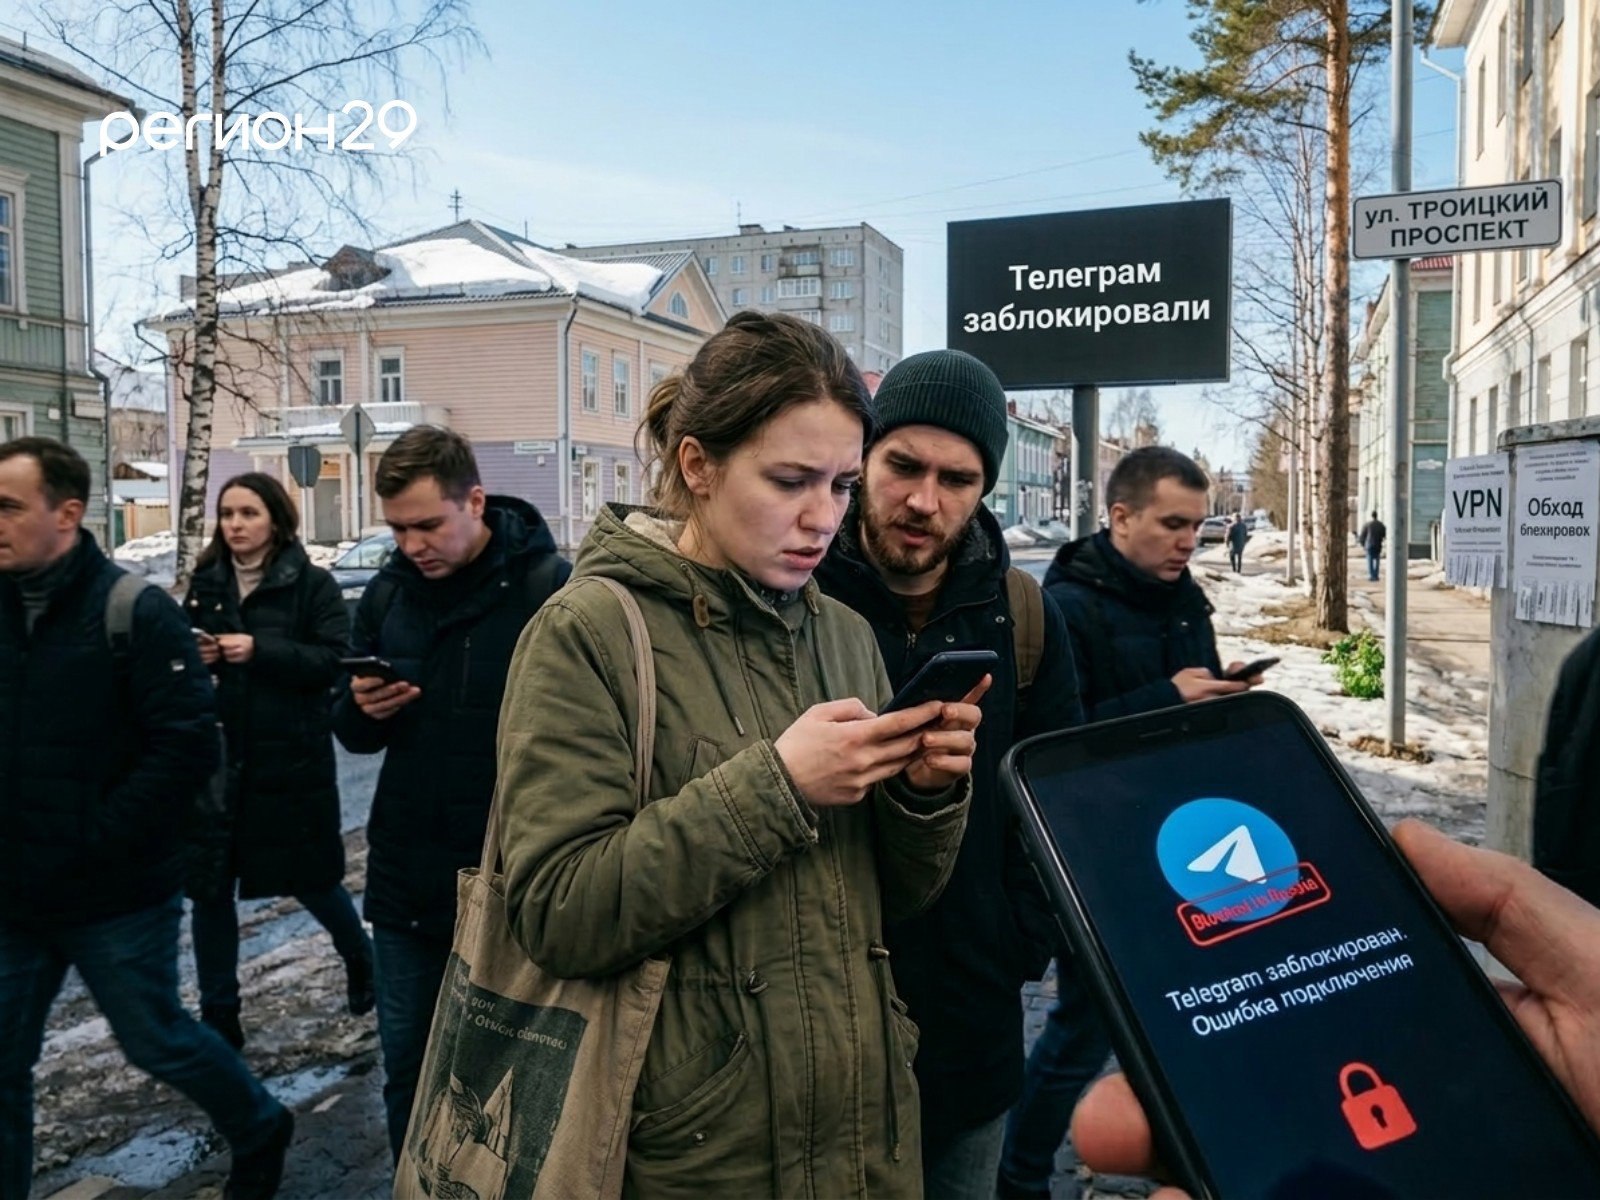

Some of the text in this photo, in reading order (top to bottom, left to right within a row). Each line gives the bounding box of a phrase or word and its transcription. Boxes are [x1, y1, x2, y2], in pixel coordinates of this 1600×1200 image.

[1365, 186, 1549, 229] ул. ТРОИЦКИЙ
[1391, 218, 1529, 247] ПРОСПЕКТ
[1008, 262, 1161, 293] Телеграм
[963, 299, 1210, 333] заблокировали
[1453, 487, 1502, 519] VPN
[1528, 497, 1584, 519] Обход
[1165, 927, 1408, 1011] Telegram заблокирован.
[1192, 953, 1414, 1036] Ошибка подключения
